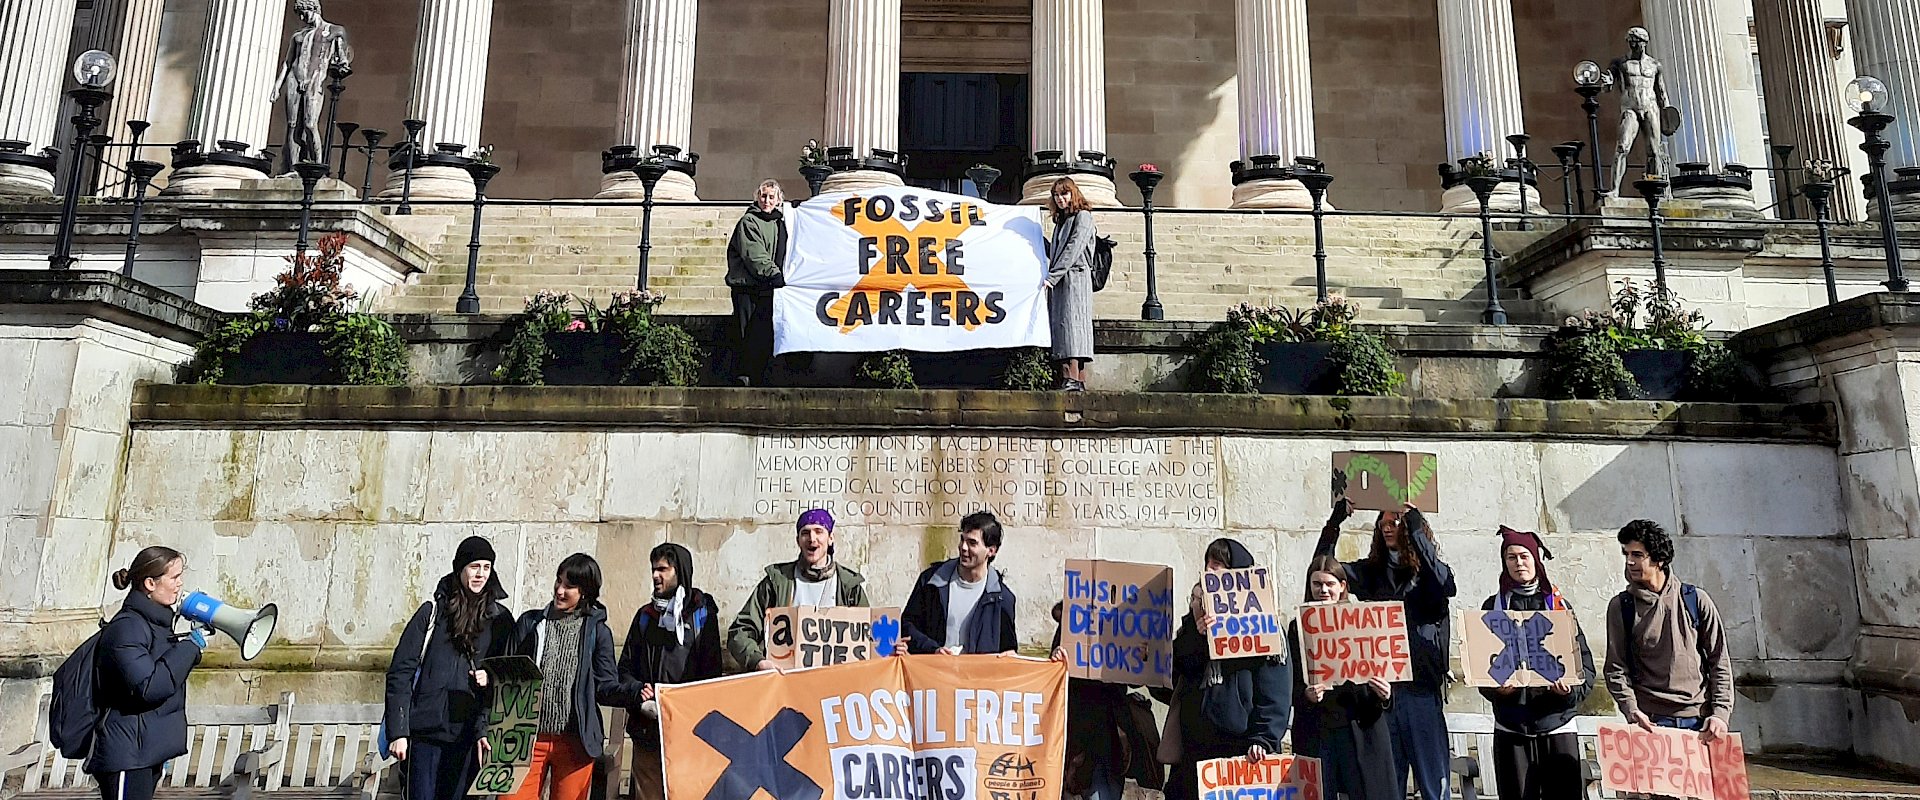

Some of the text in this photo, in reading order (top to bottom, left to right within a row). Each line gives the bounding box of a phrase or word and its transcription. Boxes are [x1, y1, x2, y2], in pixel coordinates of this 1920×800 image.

[858, 235, 965, 275] FREE
[815, 291, 1007, 326] CAREERS
[760, 434, 1214, 455] THIS INSCRIPTION IS PLACED HERE TO PERPETUATE THE
[758, 455, 1215, 477] MEMORY OF THE MEMBERS OF THE COLLEGE AND OF
[757, 476, 1215, 499] THE MEDICAL SCHOOL WHO DIED IN THE SERVICE
[755, 499, 778, 515] OF
[846, 500, 933, 517] COUNTRY
[1024, 502, 1060, 518] THE
[1072, 503, 1127, 520] YEARS
[1065, 570, 1109, 602] THIS
[1122, 584, 1140, 604] IS
[1205, 568, 1267, 593] DON'T
[1244, 591, 1263, 613] A
[1211, 614, 1278, 637] FOSSIL
[1301, 605, 1404, 634] CLIMATE
[1076, 641, 1145, 674] LOOKS
[1214, 635, 1270, 656] FOOL
[1308, 634, 1408, 660] JUSTICE
[821, 689, 1044, 746] FOSSIL FREE
[487, 723, 537, 763] NOT
[1599, 726, 1683, 766] FOSSIL
[842, 752, 966, 800] CAREERS
[989, 780, 1010, 788] people
[1020, 780, 1041, 788] planet
[1201, 758, 1292, 789] CLIMATE
[1608, 762, 1664, 790] OFF
